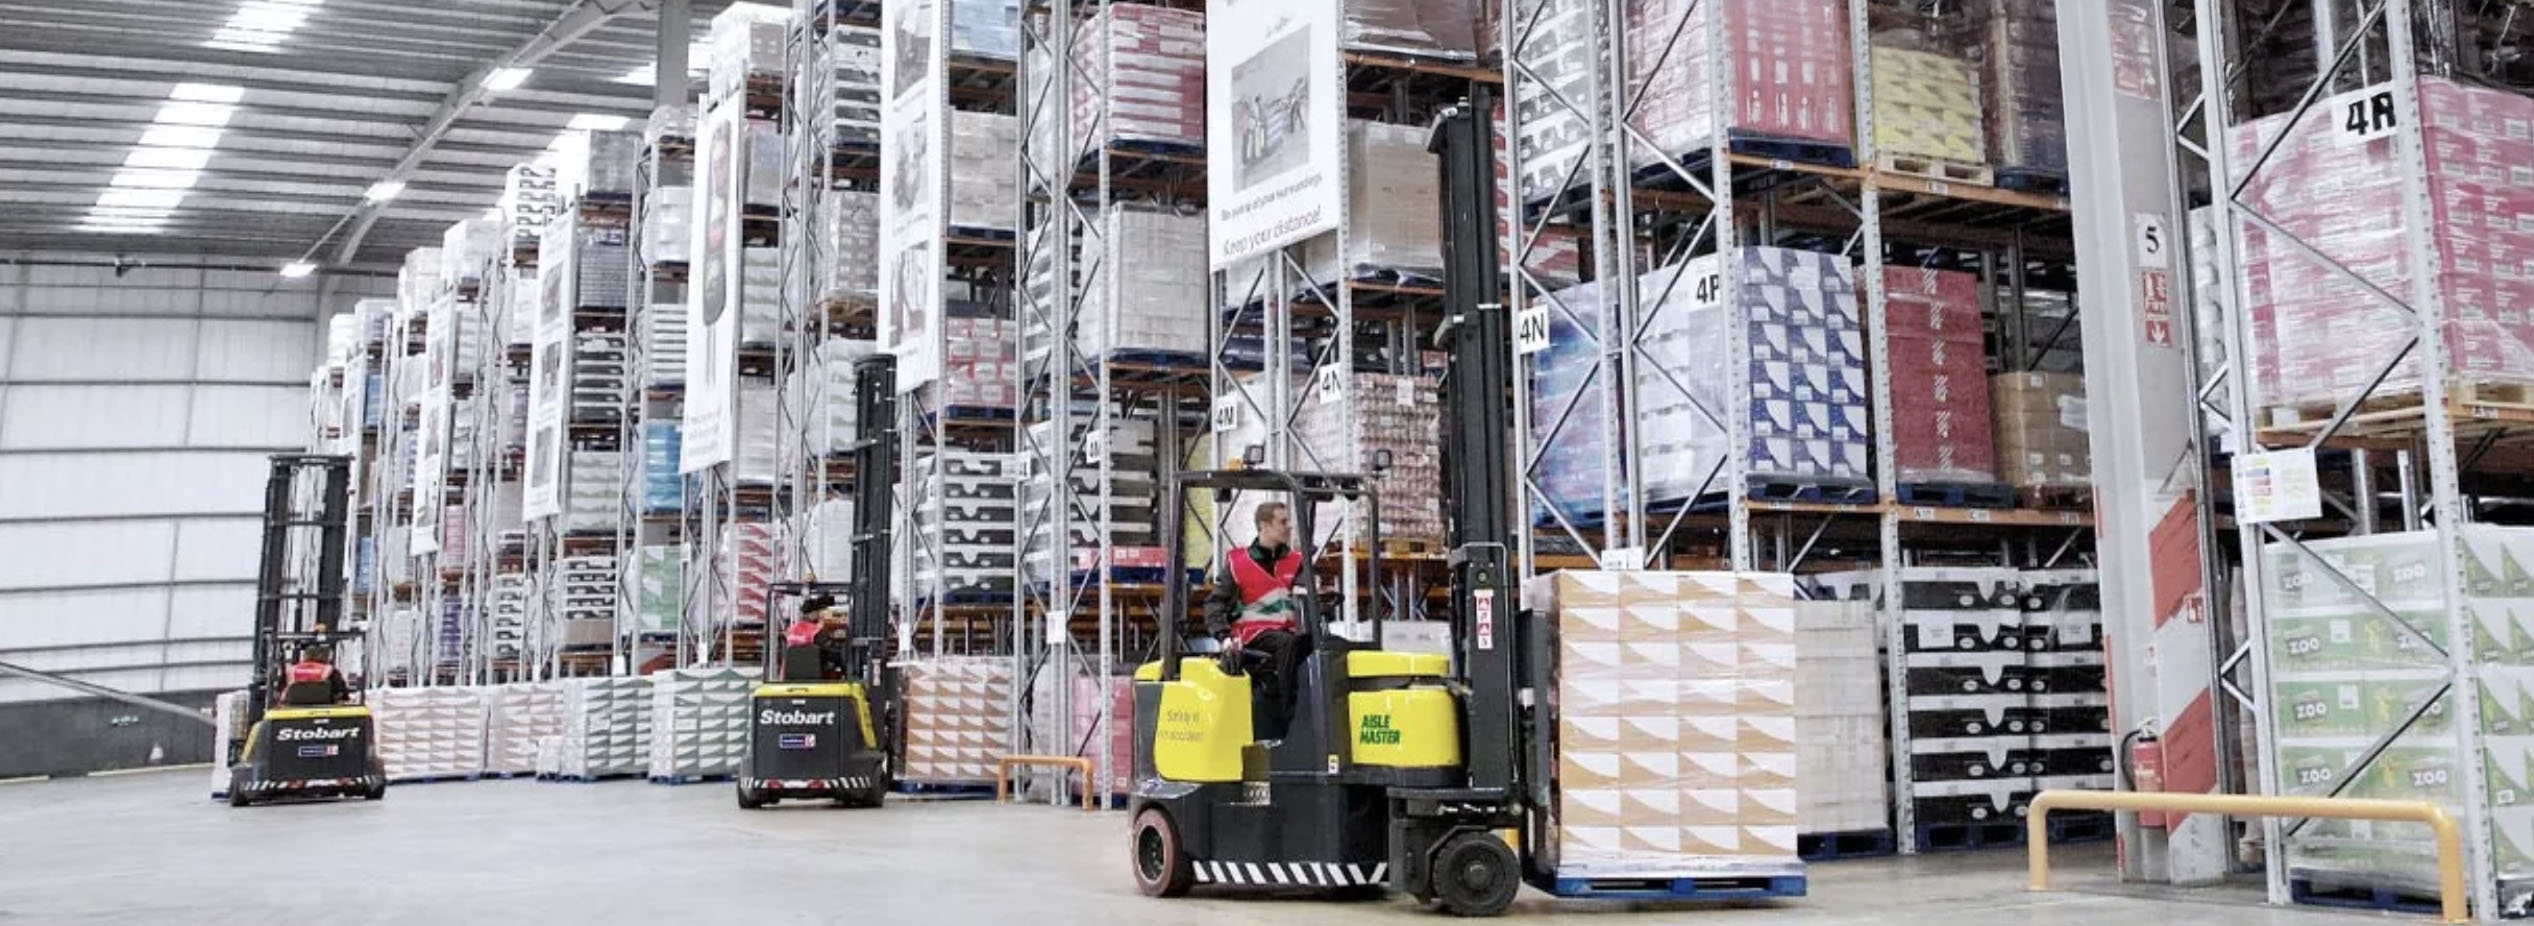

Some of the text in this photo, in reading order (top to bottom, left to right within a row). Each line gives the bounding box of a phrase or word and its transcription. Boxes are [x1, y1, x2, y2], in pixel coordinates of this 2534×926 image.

[2346, 91, 2396, 136] 4R
[1224, 203, 1322, 256] Keep your distance!
[2145, 225, 2160, 254] 5
[1520, 312, 1545, 345] 4N
[2290, 636, 2320, 655] ZOO
[760, 708, 835, 725] Stobart
[2295, 702, 2327, 720] ZOO
[1361, 714, 1391, 728] AISLE
[277, 726, 361, 741] Stobart
[1360, 730, 1400, 745] MASTER
[2301, 767, 2331, 785] ZOO
[2413, 769, 2447, 787] ZOO
